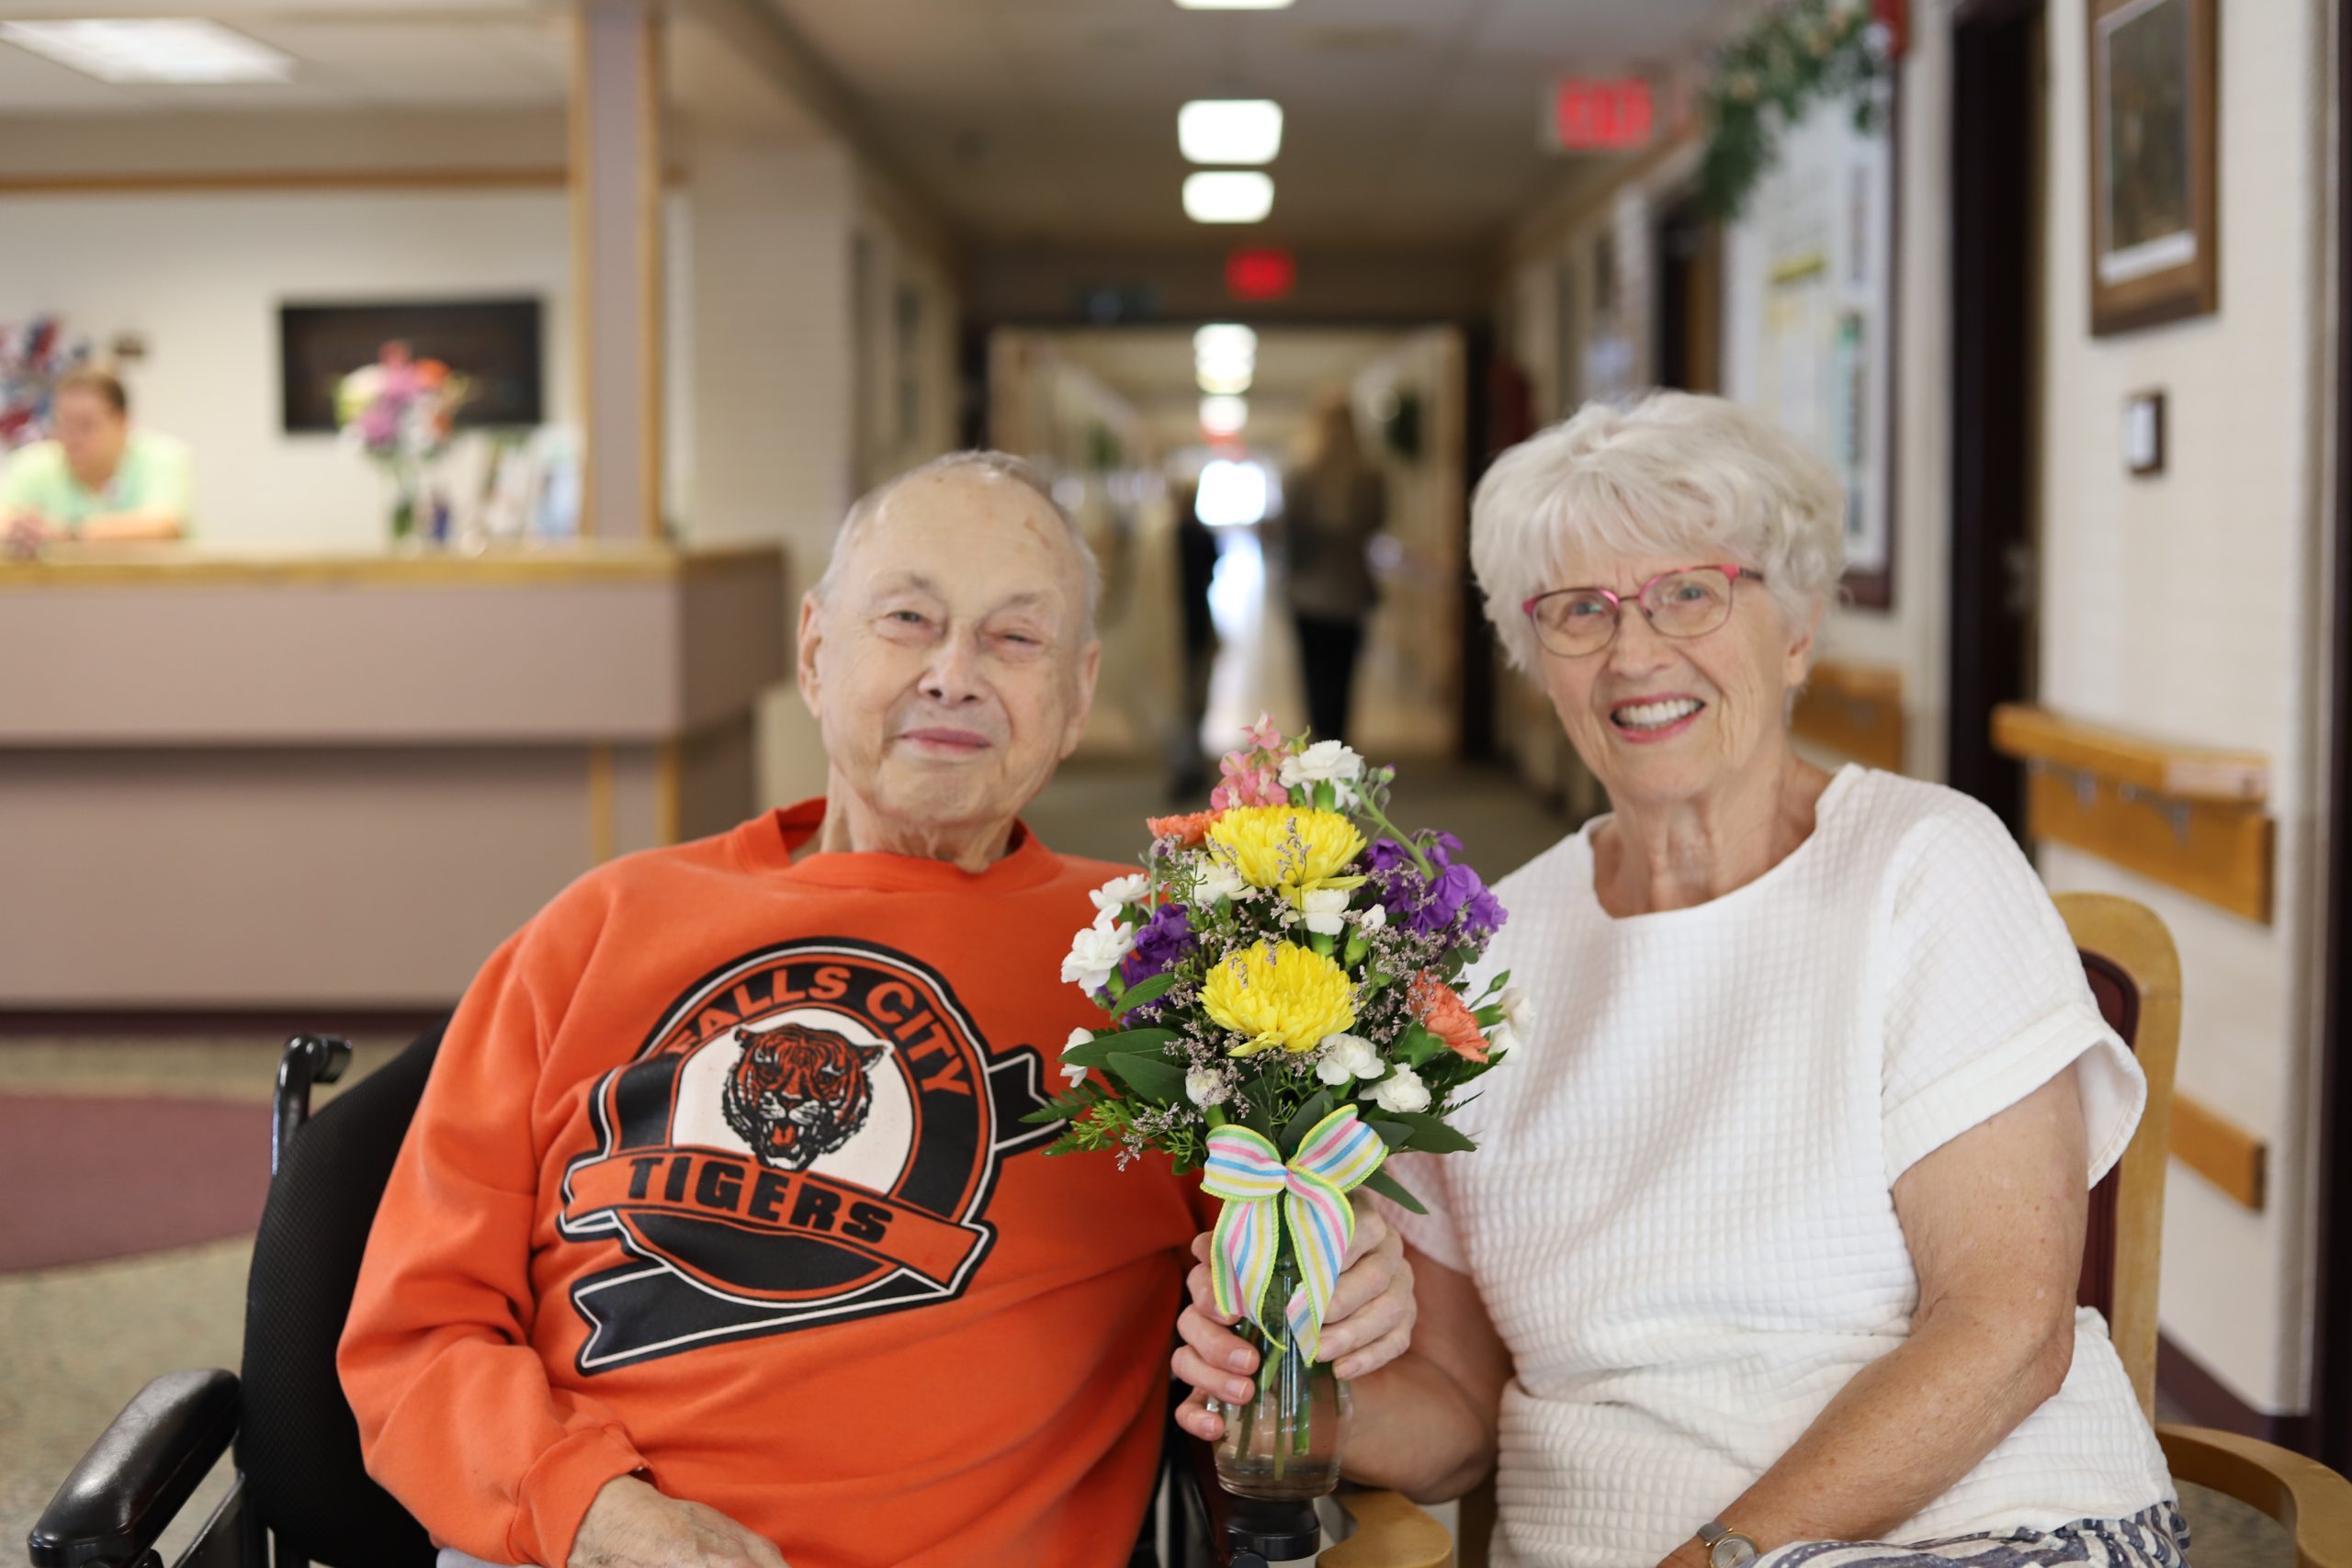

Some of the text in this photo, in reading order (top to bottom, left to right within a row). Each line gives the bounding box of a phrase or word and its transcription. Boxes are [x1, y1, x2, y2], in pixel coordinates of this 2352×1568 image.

[664, 966, 971, 1096] FALLS CITY
[628, 1156, 893, 1243] TIGERS
